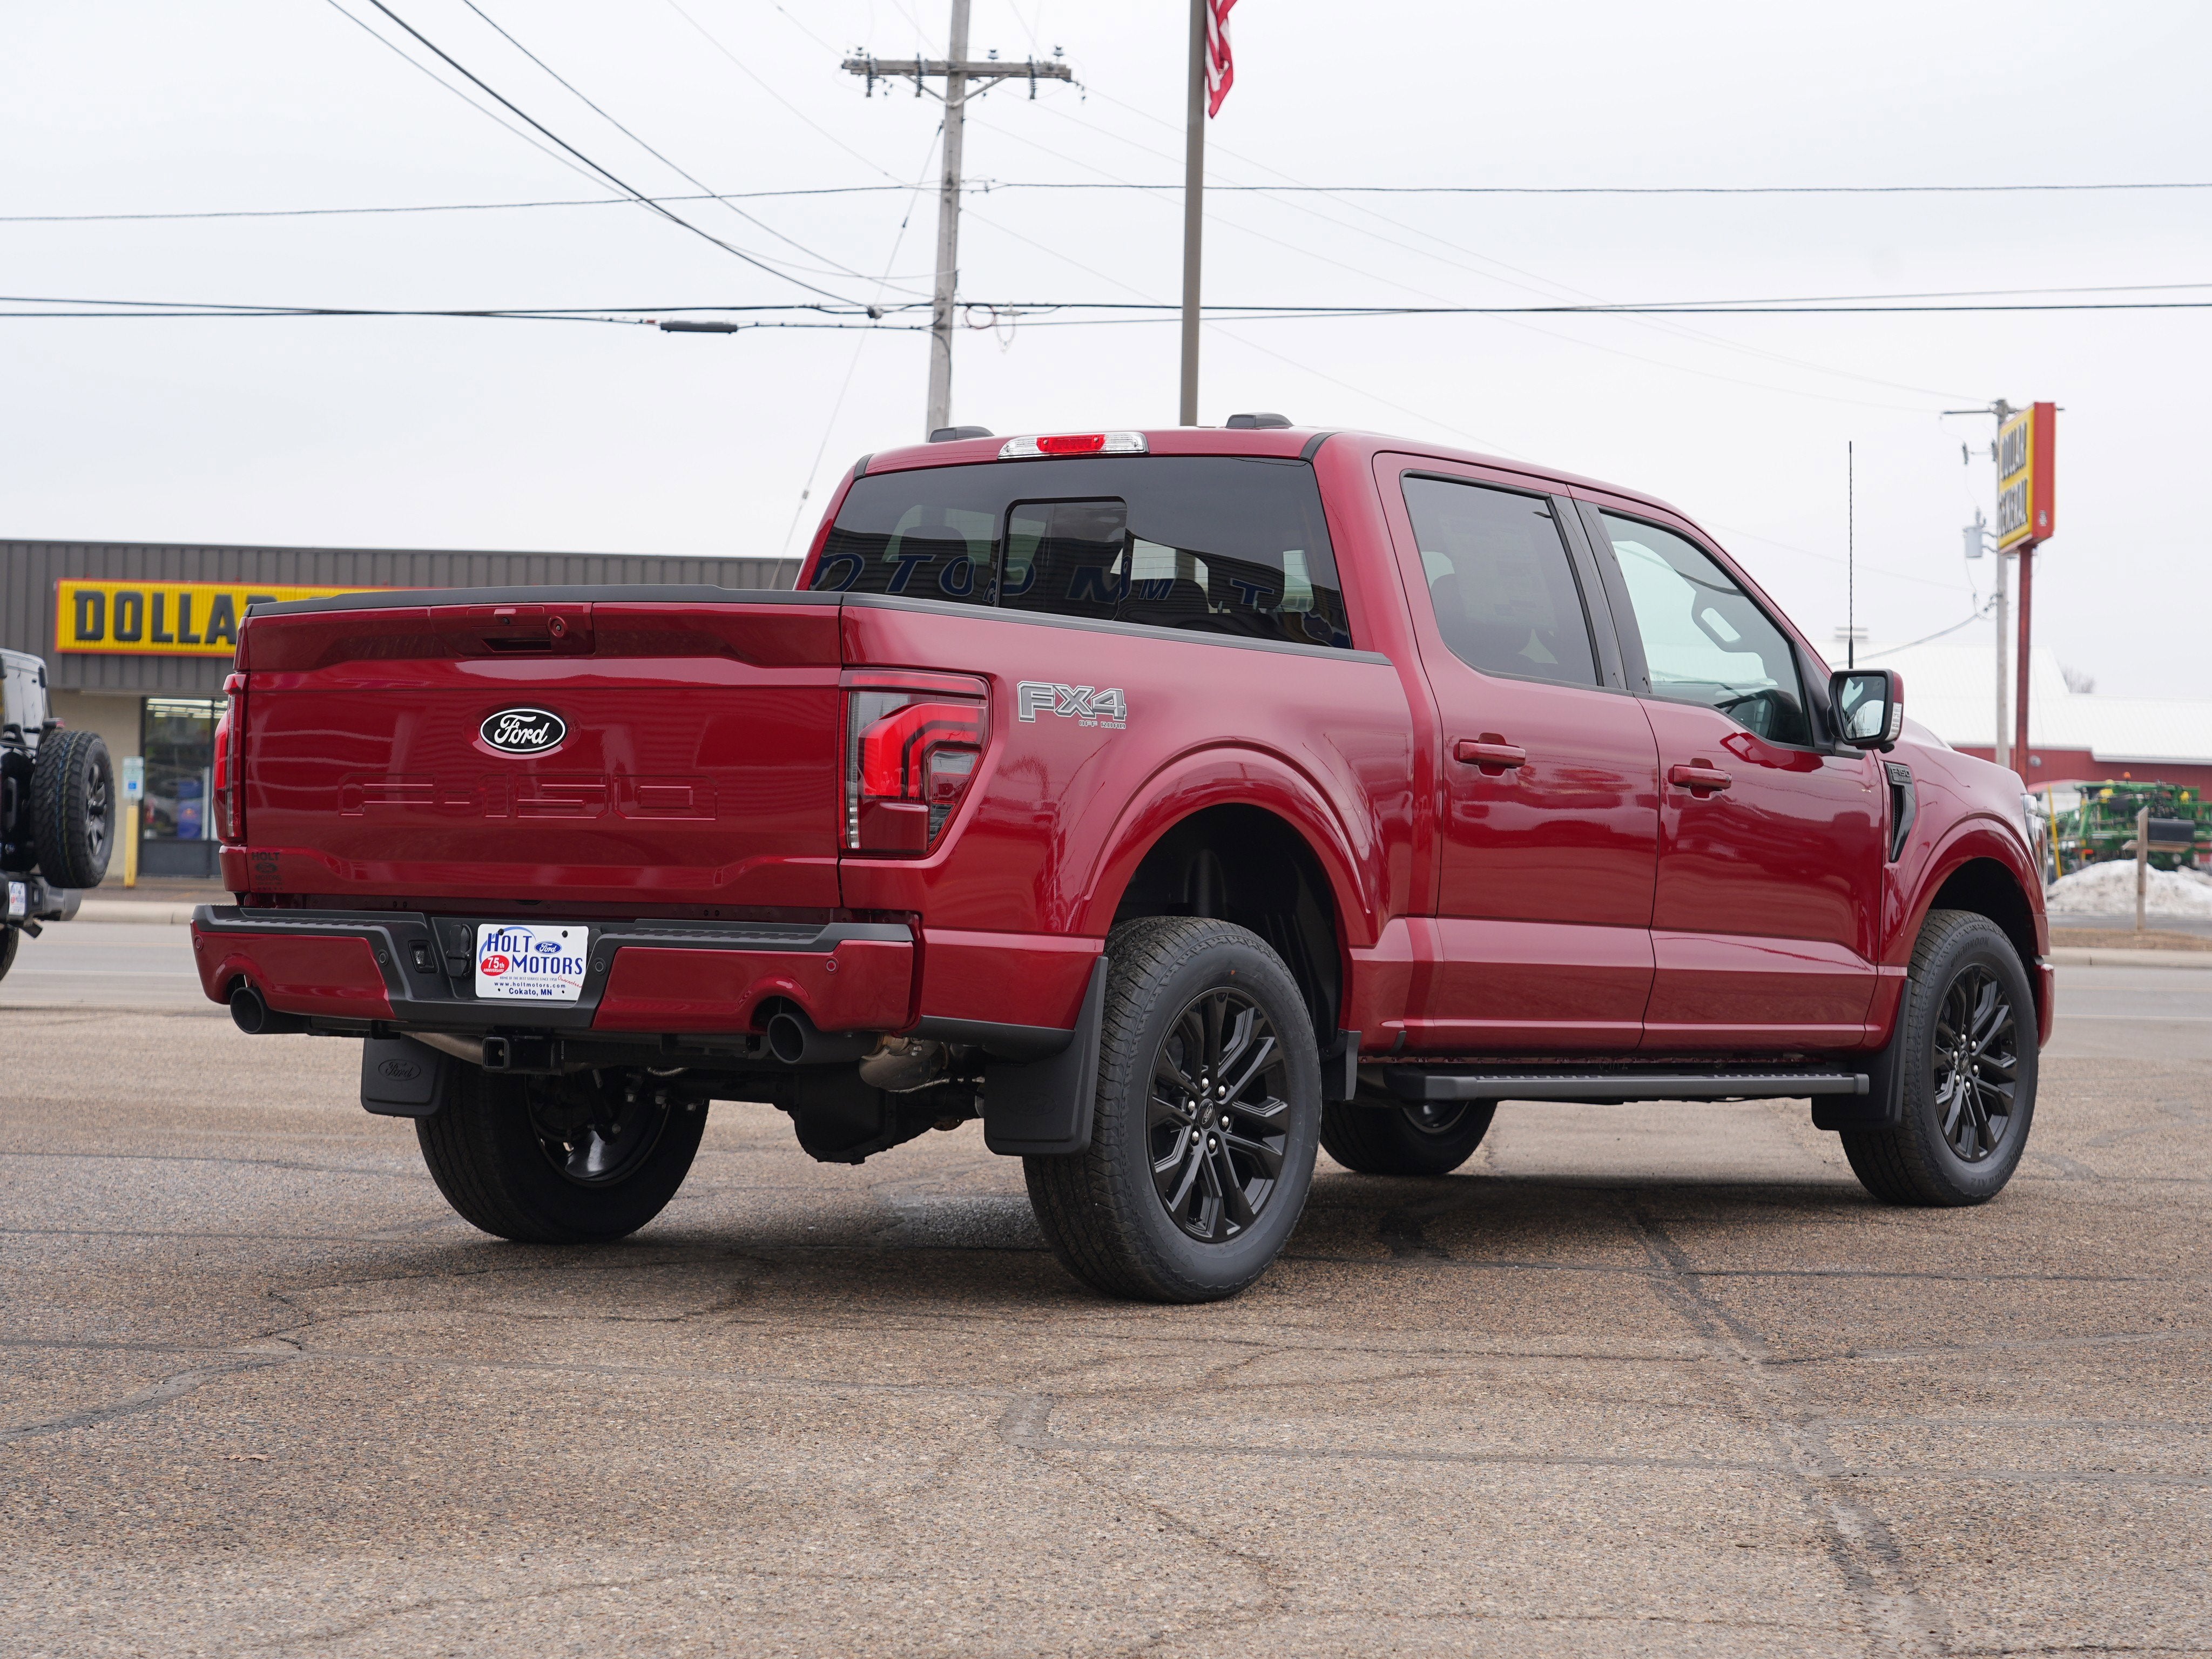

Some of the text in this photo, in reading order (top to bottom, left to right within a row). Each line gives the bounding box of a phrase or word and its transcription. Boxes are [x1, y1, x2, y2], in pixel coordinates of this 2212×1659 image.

[73, 590, 278, 645] DOLLA
[1017, 680, 1127, 723] FX4
[494, 714, 550, 744] Ford
[1078, 719, 1127, 730] OFF ROAD
[251, 852, 280, 861] HOLT
[487, 933, 532, 953] HOLT
[539, 942, 557, 954] Ford
[487, 957, 505, 969] 75th
[511, 954, 583, 975] MOTORS
[509, 988, 538, 996] Cokato,
[385, 1062, 414, 1077] Ford
